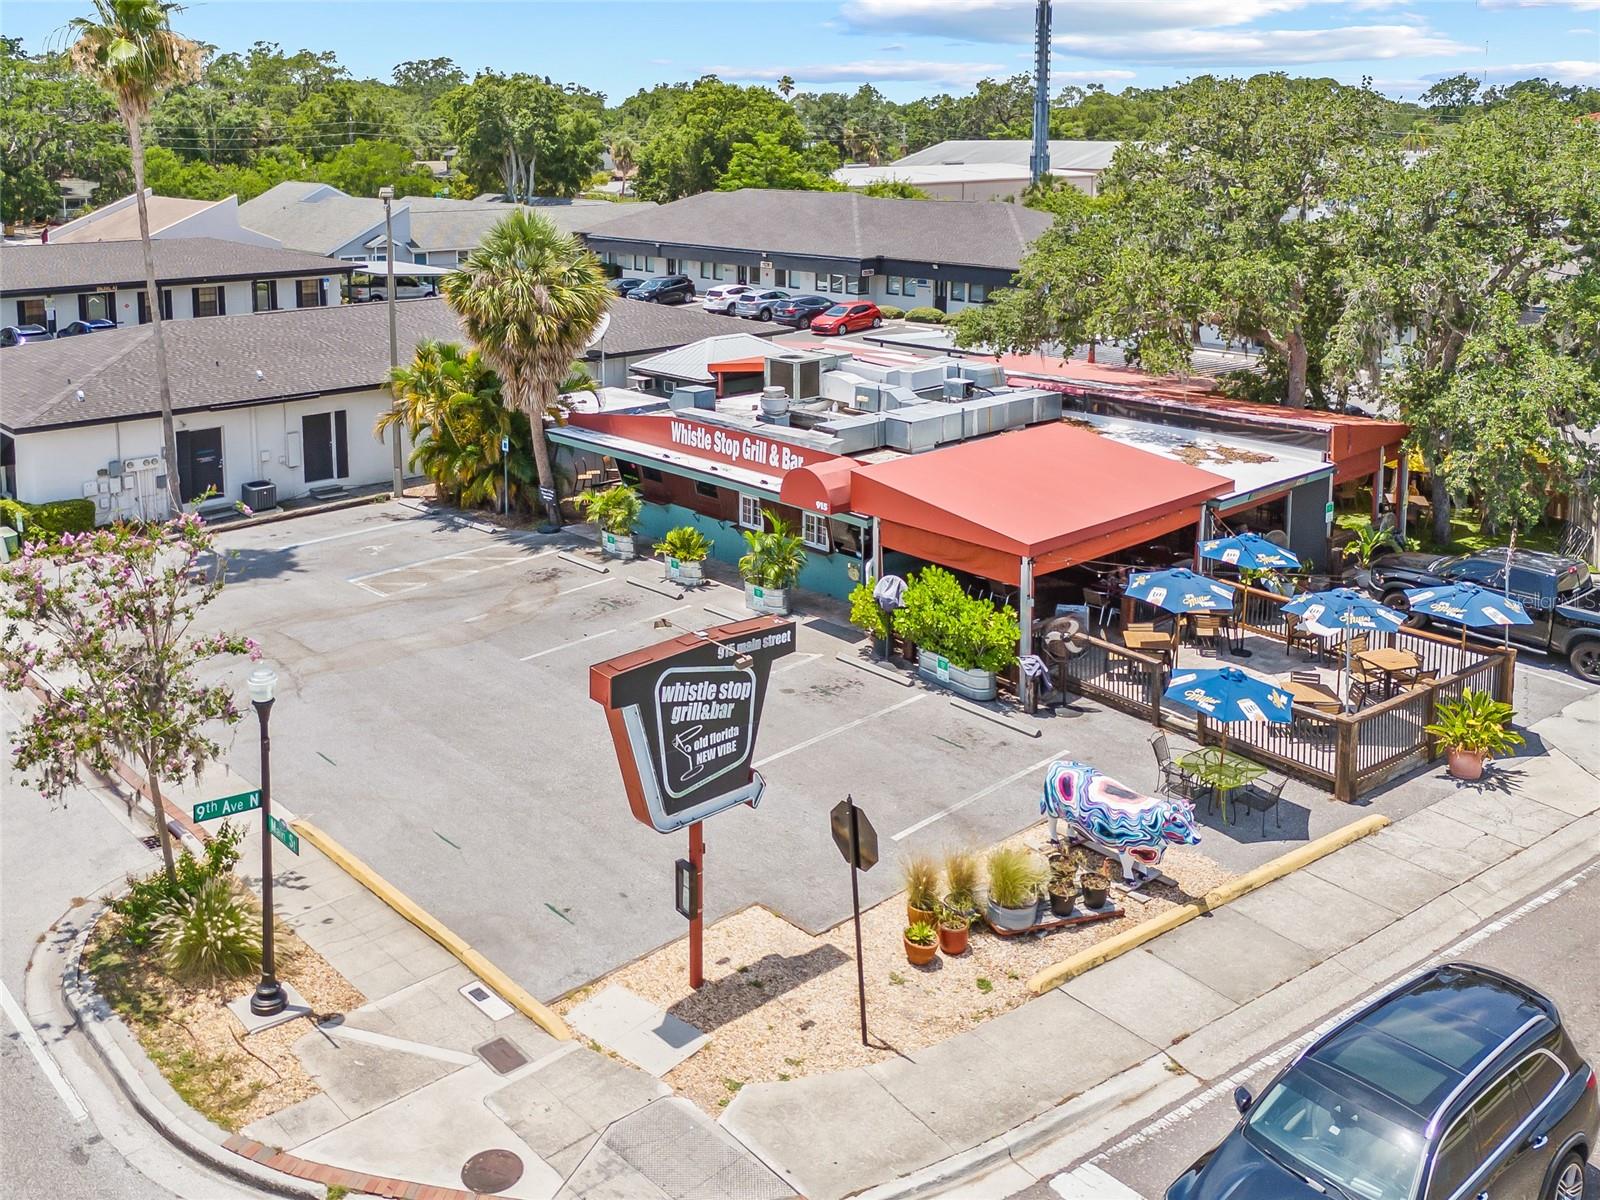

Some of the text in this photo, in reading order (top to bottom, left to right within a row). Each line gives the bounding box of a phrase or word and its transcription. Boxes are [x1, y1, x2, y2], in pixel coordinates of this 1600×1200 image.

[671, 421, 804, 470] Whistle Stop Grill & Bar
[815, 500, 828, 511] 915
[717, 630, 792, 660] 915 main street
[661, 681, 752, 703] whistle stop
[670, 701, 736, 725] grill&bar
[693, 726, 740, 751] old florida
[696, 740, 737, 765] NEW VIBE
[196, 792, 259, 820] 9th Ave N
[271, 818, 286, 841] Main
